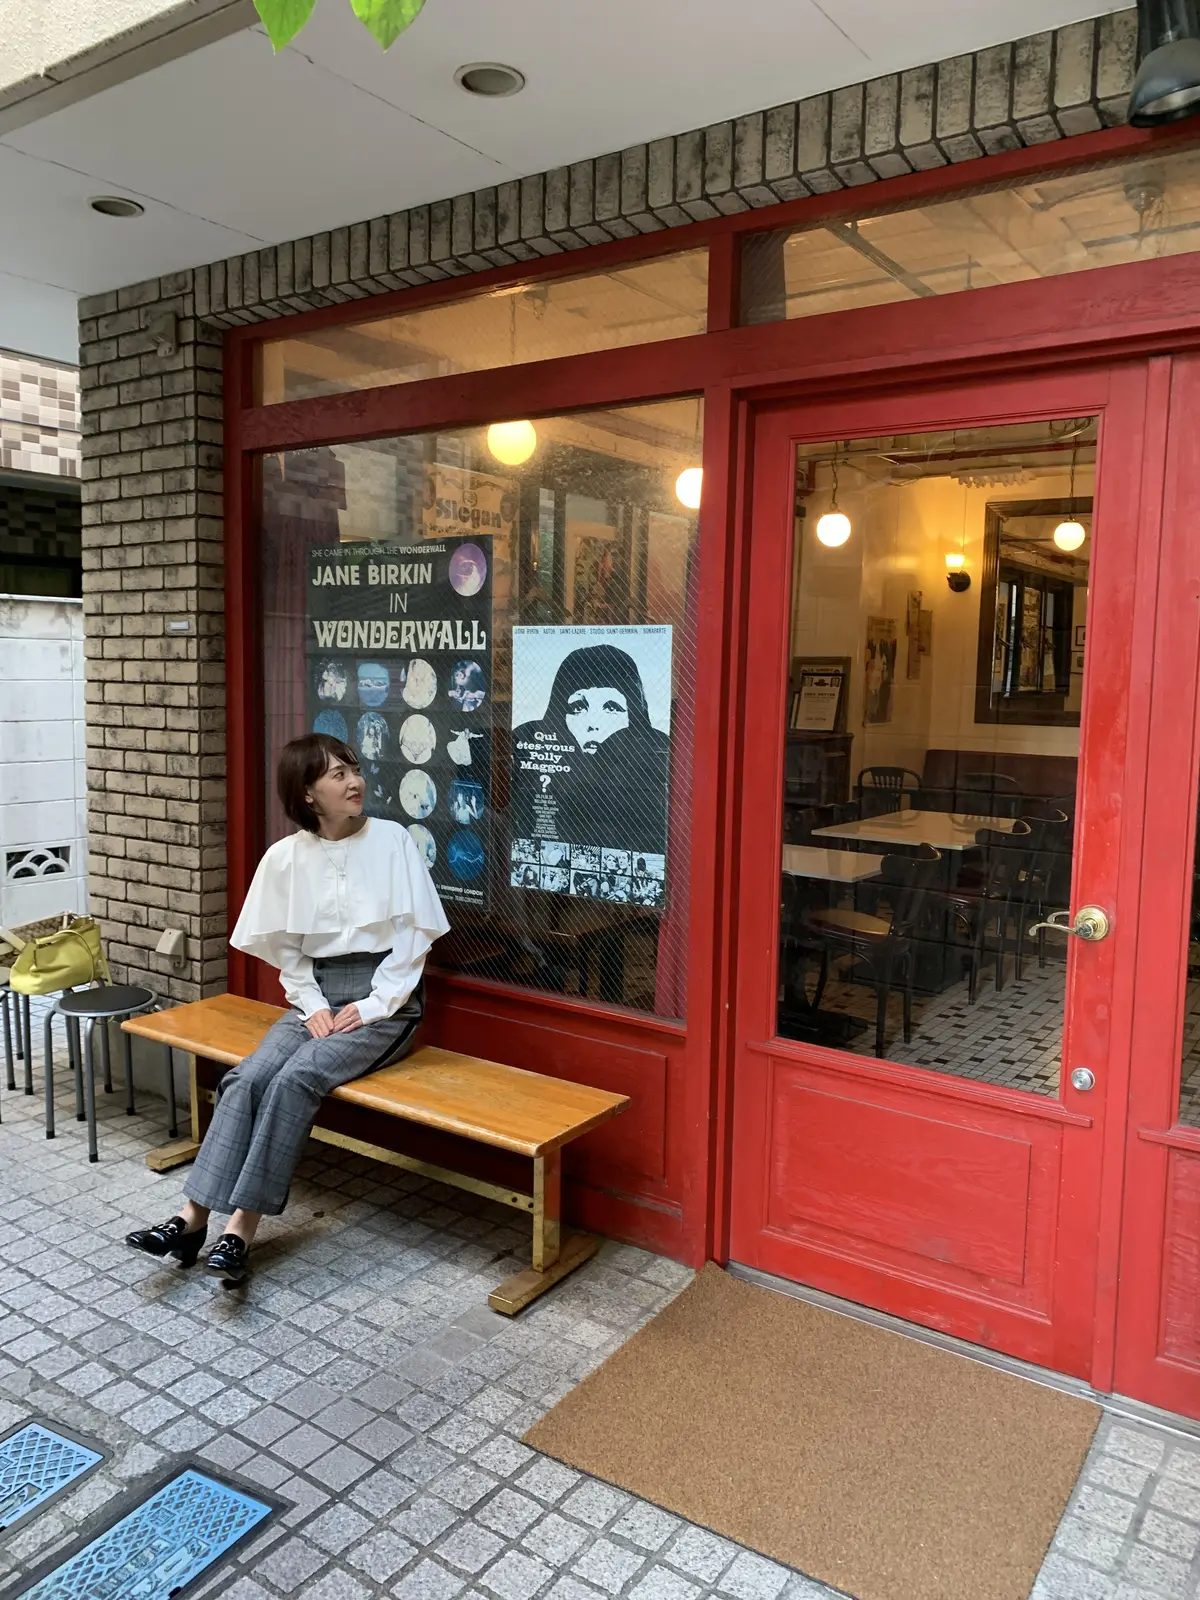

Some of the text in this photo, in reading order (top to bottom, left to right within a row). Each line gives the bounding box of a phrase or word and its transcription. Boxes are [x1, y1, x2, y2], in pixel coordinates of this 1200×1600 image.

[323, 548, 342, 557] CAME
[343, 548, 351, 557] IN
[353, 546, 385, 556] THROUGH
[399, 544, 446, 554] WONDERWALL
[311, 562, 432, 586] JANE BIRKIN
[389, 592, 408, 613] IN
[313, 620, 487, 653] WONDERWALL
[533, 731, 558, 742] Qui
[516, 741, 575, 752] êtes-vous
[529, 751, 563, 764] Polly
[520, 760, 571, 773] Maggoo
[539, 774, 552, 793] ?
